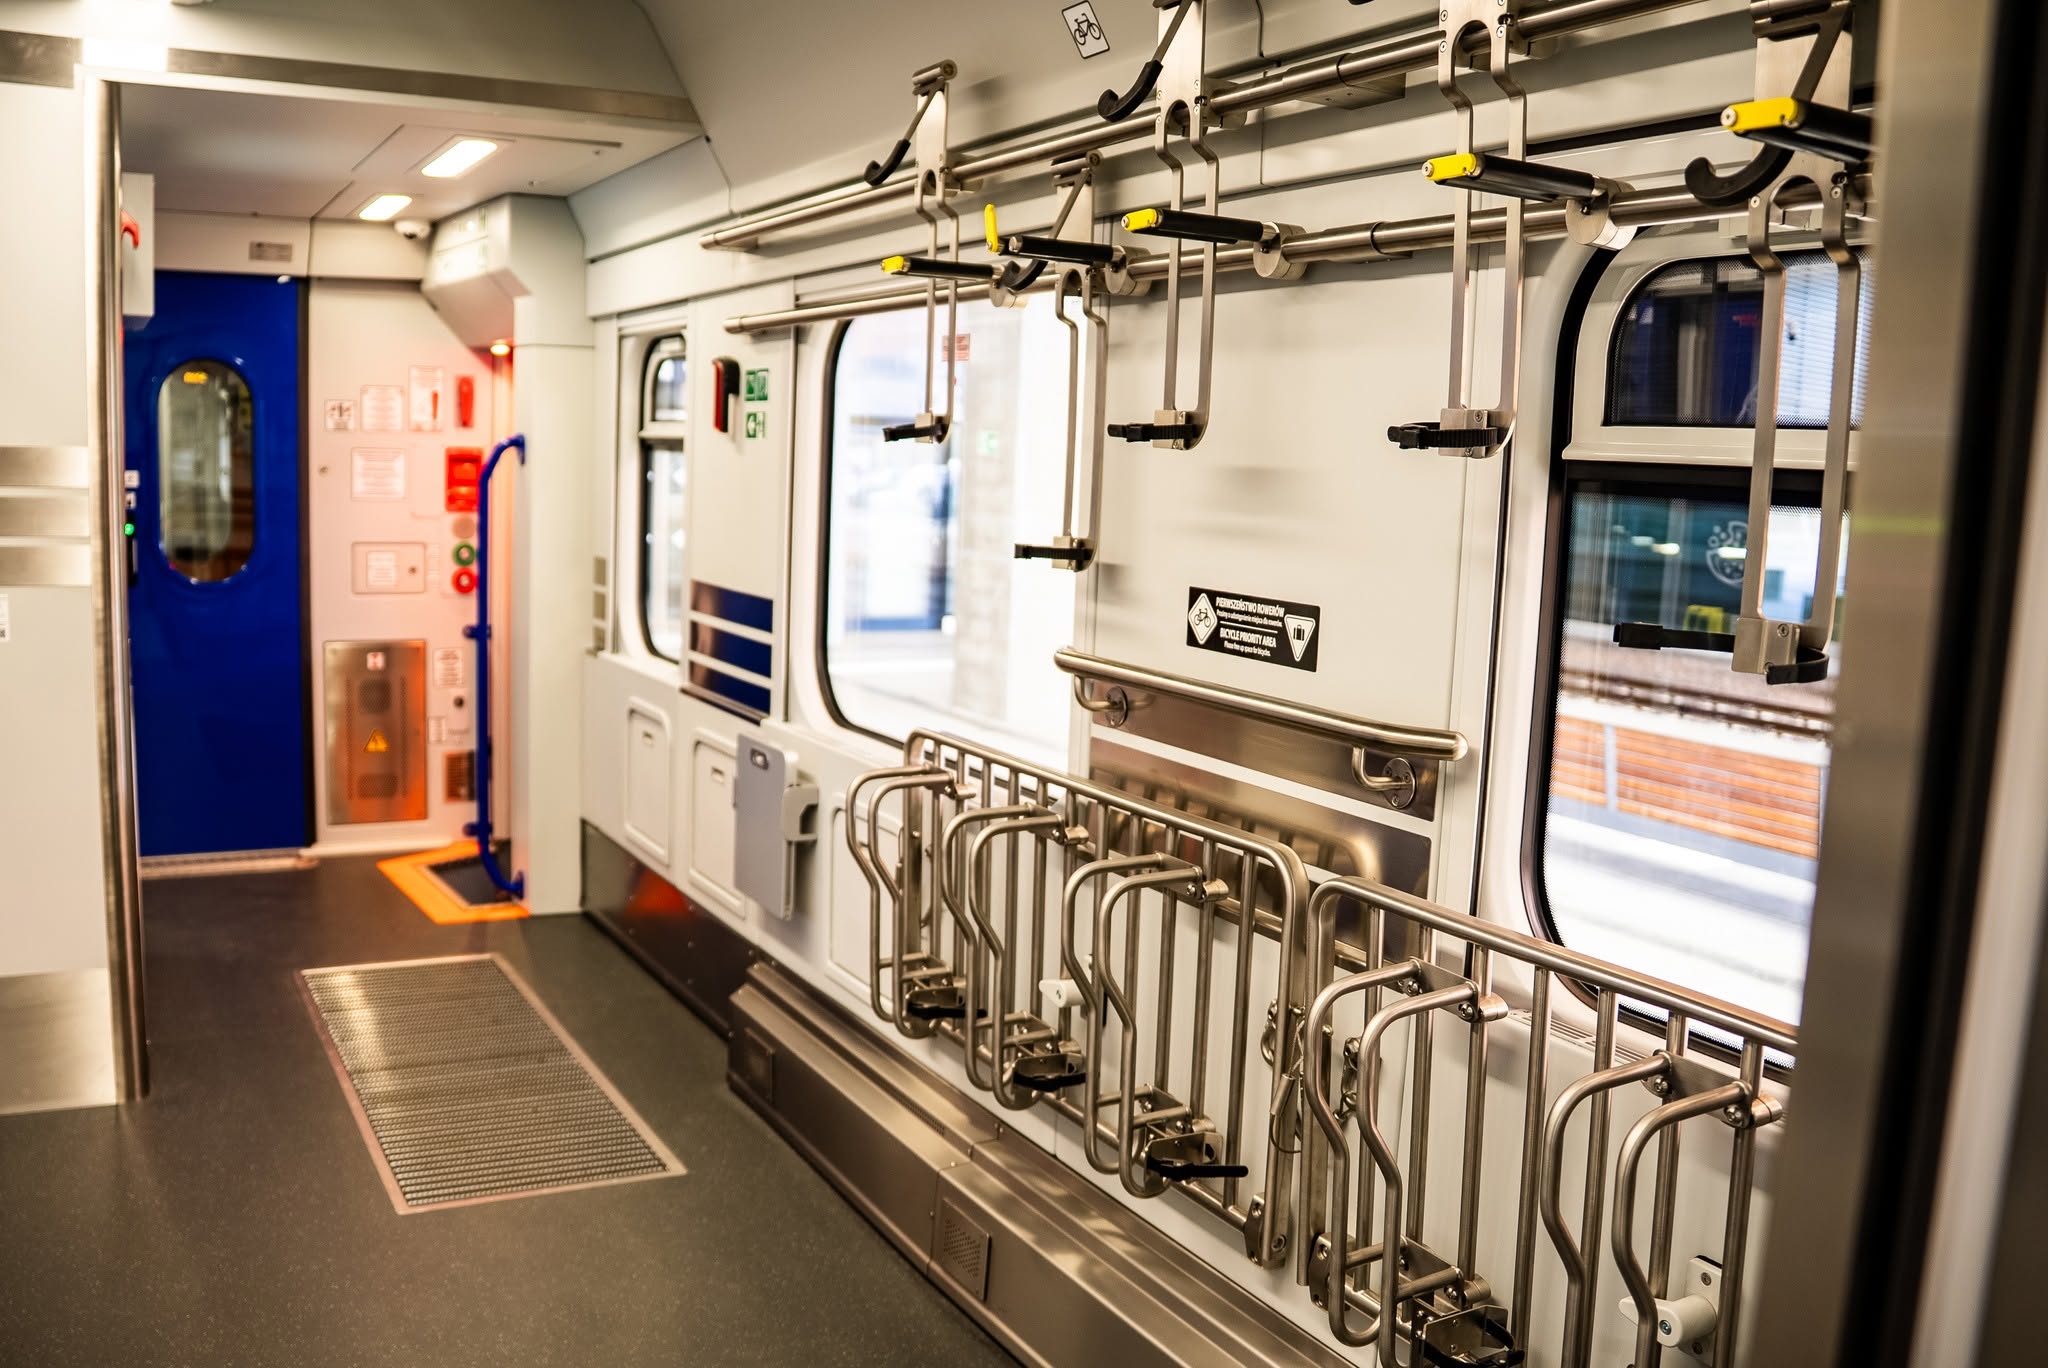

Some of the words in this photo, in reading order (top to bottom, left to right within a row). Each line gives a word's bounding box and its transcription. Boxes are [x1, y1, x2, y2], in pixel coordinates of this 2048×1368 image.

[1257, 603, 1285, 618] ROWERÓW
[1220, 627, 1240, 641] BICYCLE
[1239, 631, 1262, 645] PRIORITY
[1262, 635, 1277, 648] AREA
